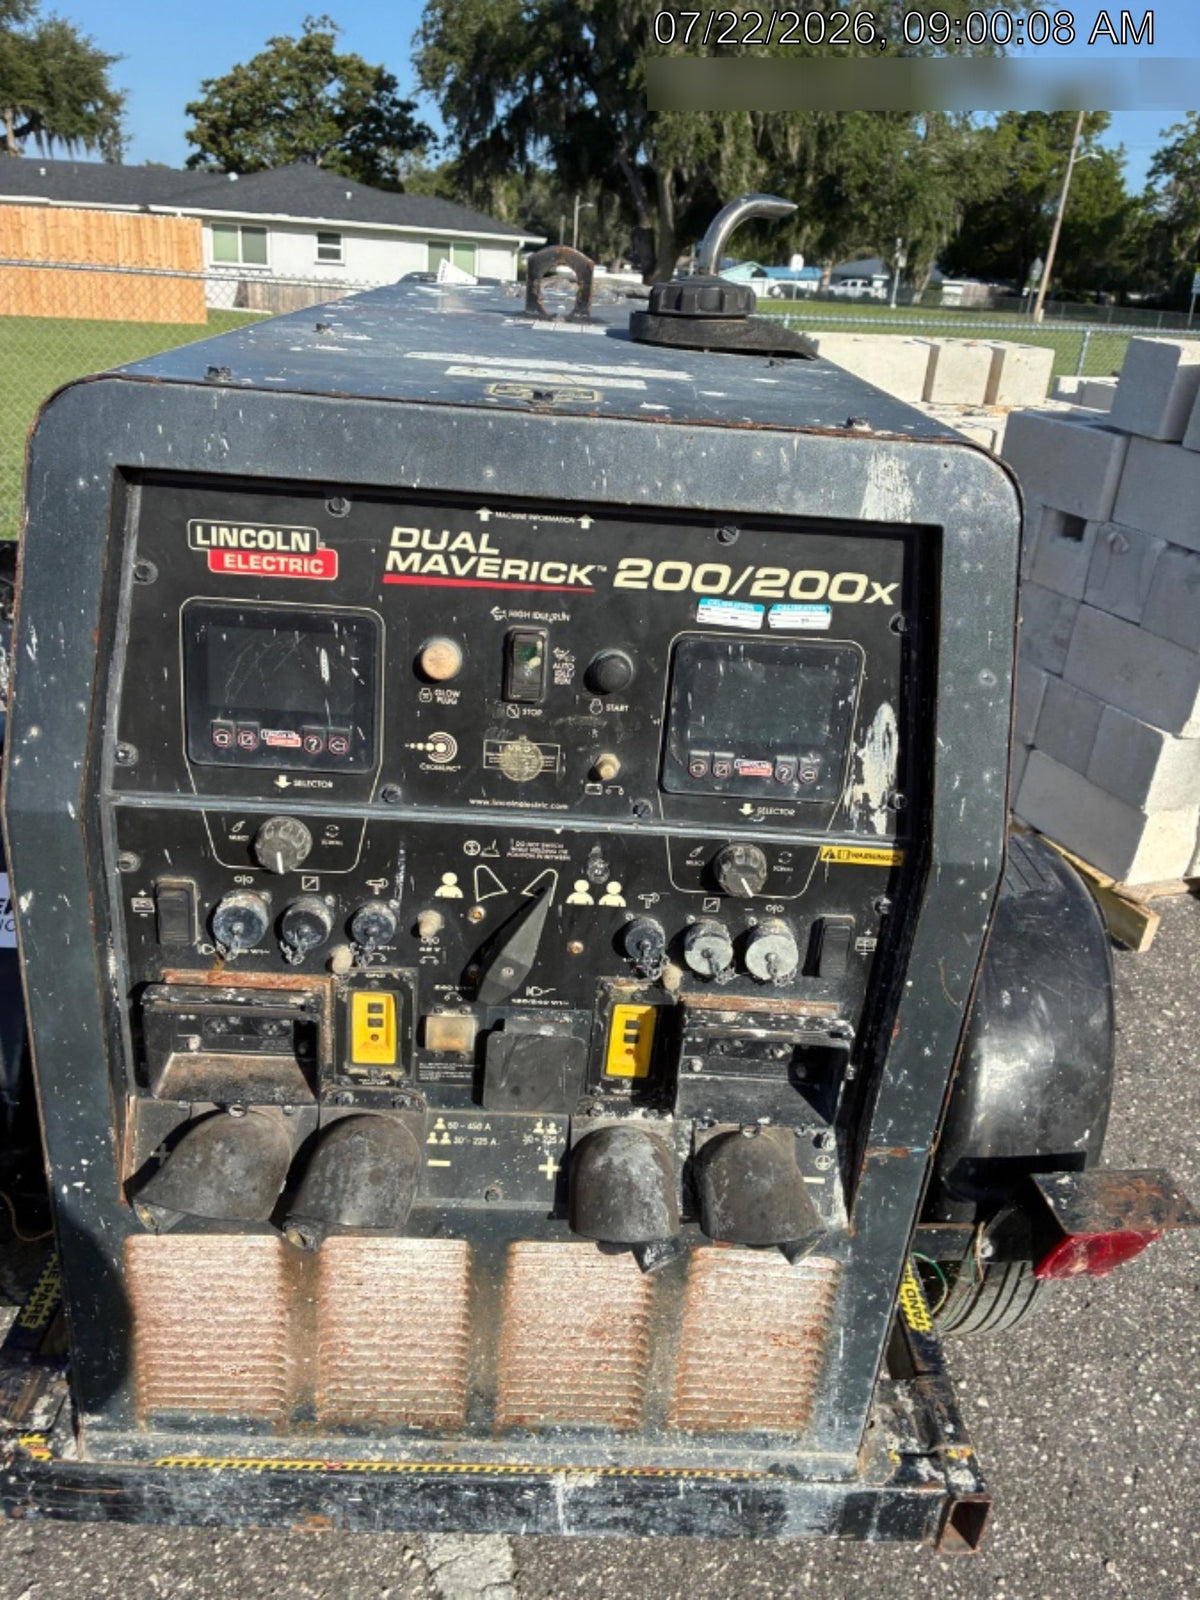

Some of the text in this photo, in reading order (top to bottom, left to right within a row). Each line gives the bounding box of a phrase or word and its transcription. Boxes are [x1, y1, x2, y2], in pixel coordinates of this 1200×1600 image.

[196, 524, 311, 553] LINCOLN
[390, 526, 499, 555] DUAL
[223, 554, 325, 576] ELECTRIC
[522, 708, 543, 717] STOP
[606, 704, 629, 712] START
